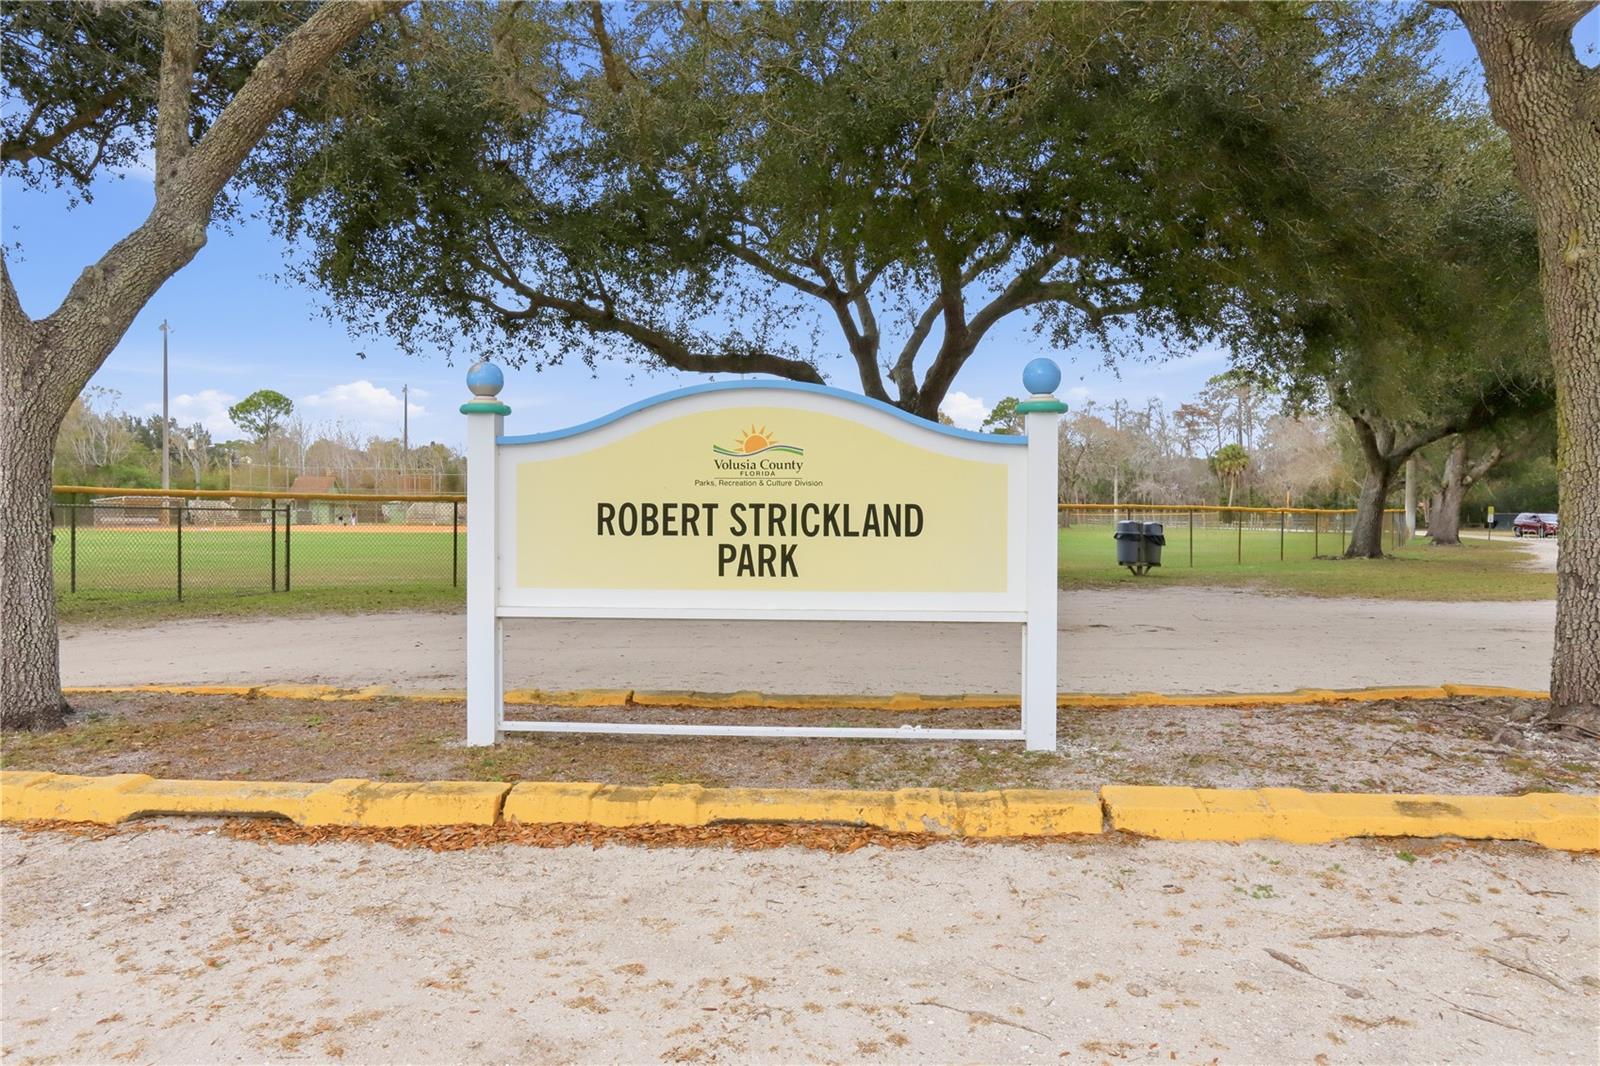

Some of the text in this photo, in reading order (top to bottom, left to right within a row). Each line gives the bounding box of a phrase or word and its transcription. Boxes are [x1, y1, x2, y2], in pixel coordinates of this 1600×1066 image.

[714, 459, 803, 474] Volusia County
[695, 480, 717, 488] Parks,
[598, 503, 923, 537] ROBERT STRICKLAND
[719, 544, 798, 577] PARK
